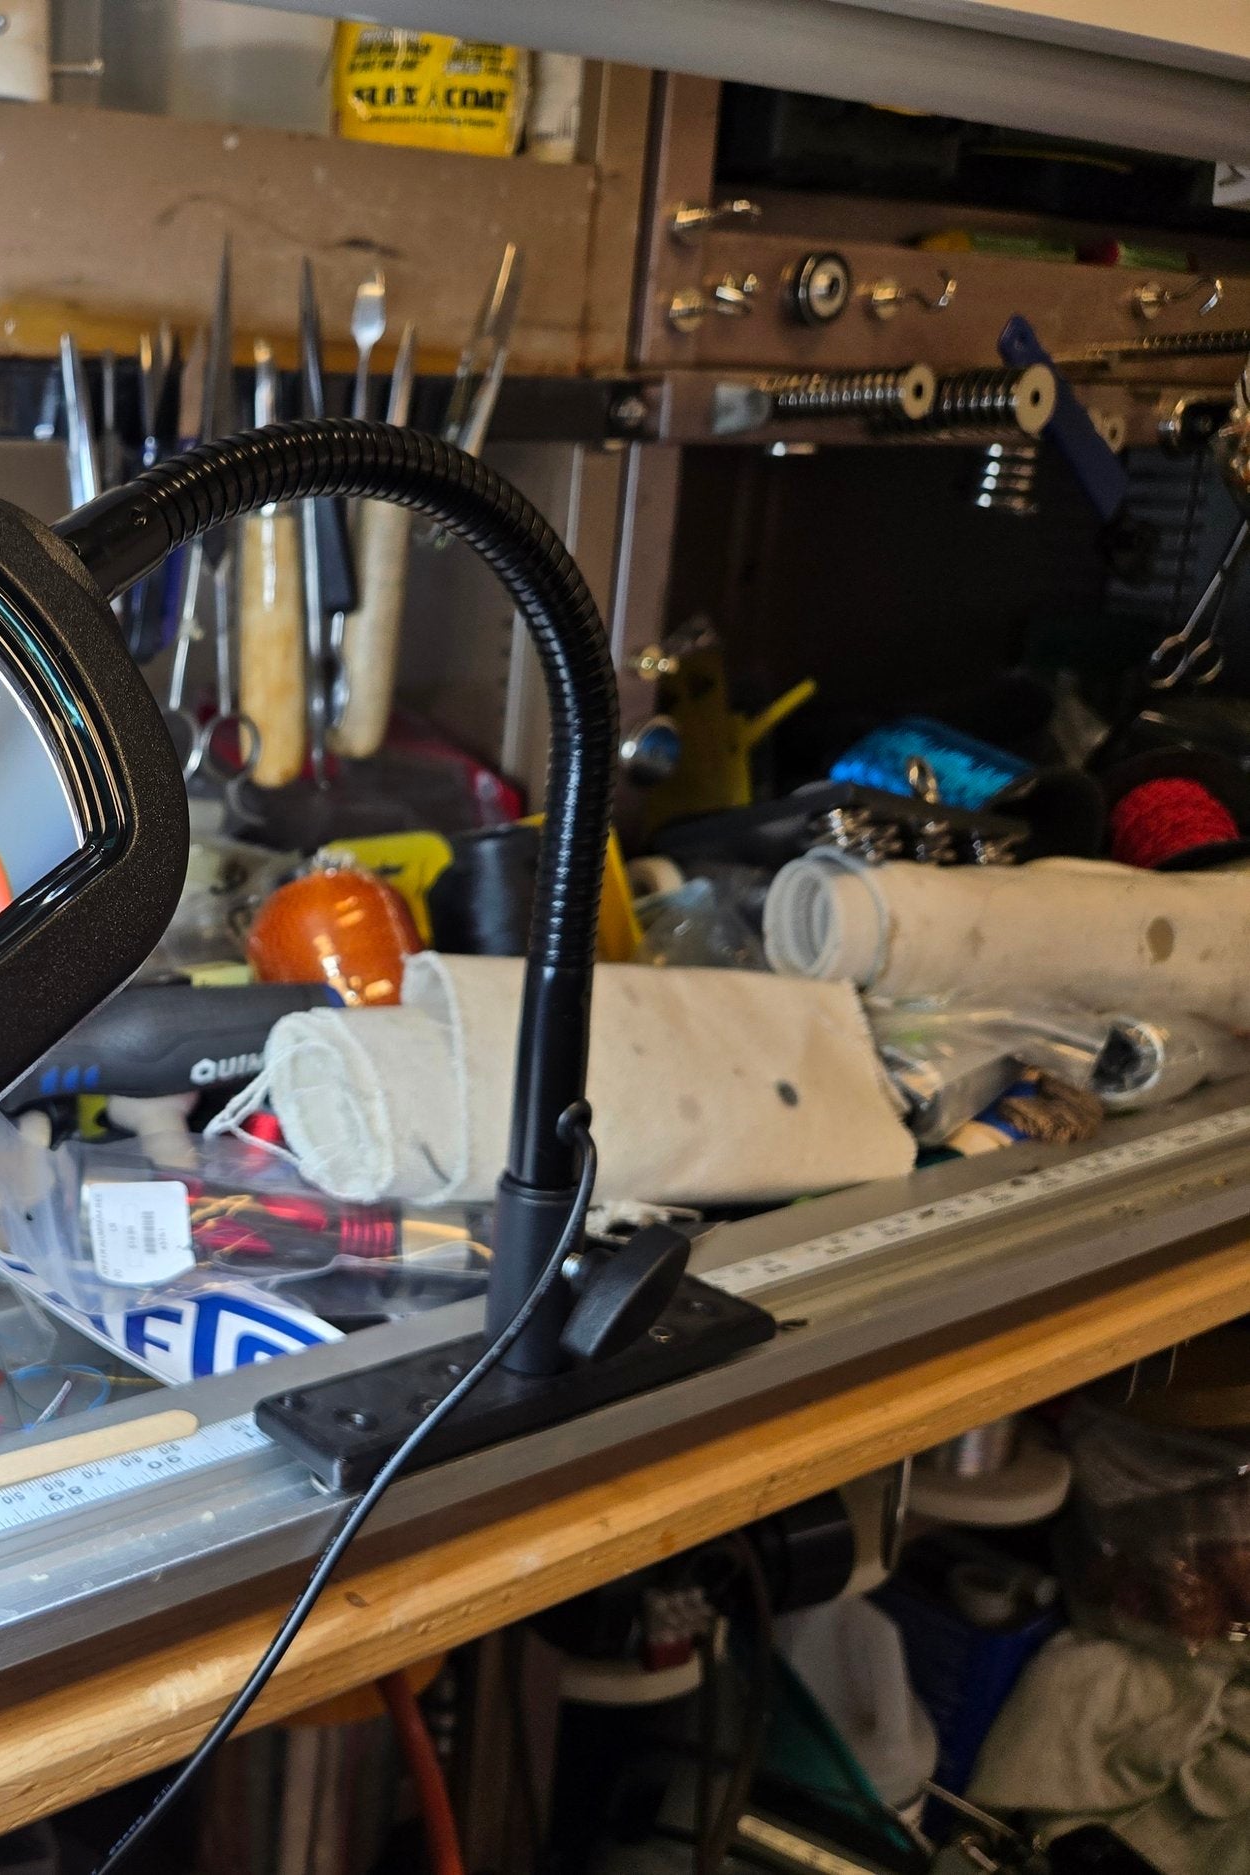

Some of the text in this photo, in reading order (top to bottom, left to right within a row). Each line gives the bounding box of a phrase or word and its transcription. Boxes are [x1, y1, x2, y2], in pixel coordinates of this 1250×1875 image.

[148, 1454, 182, 1470] 90
[1, 1491, 26, 1505] 50
[49, 1486, 84, 1502] 89
